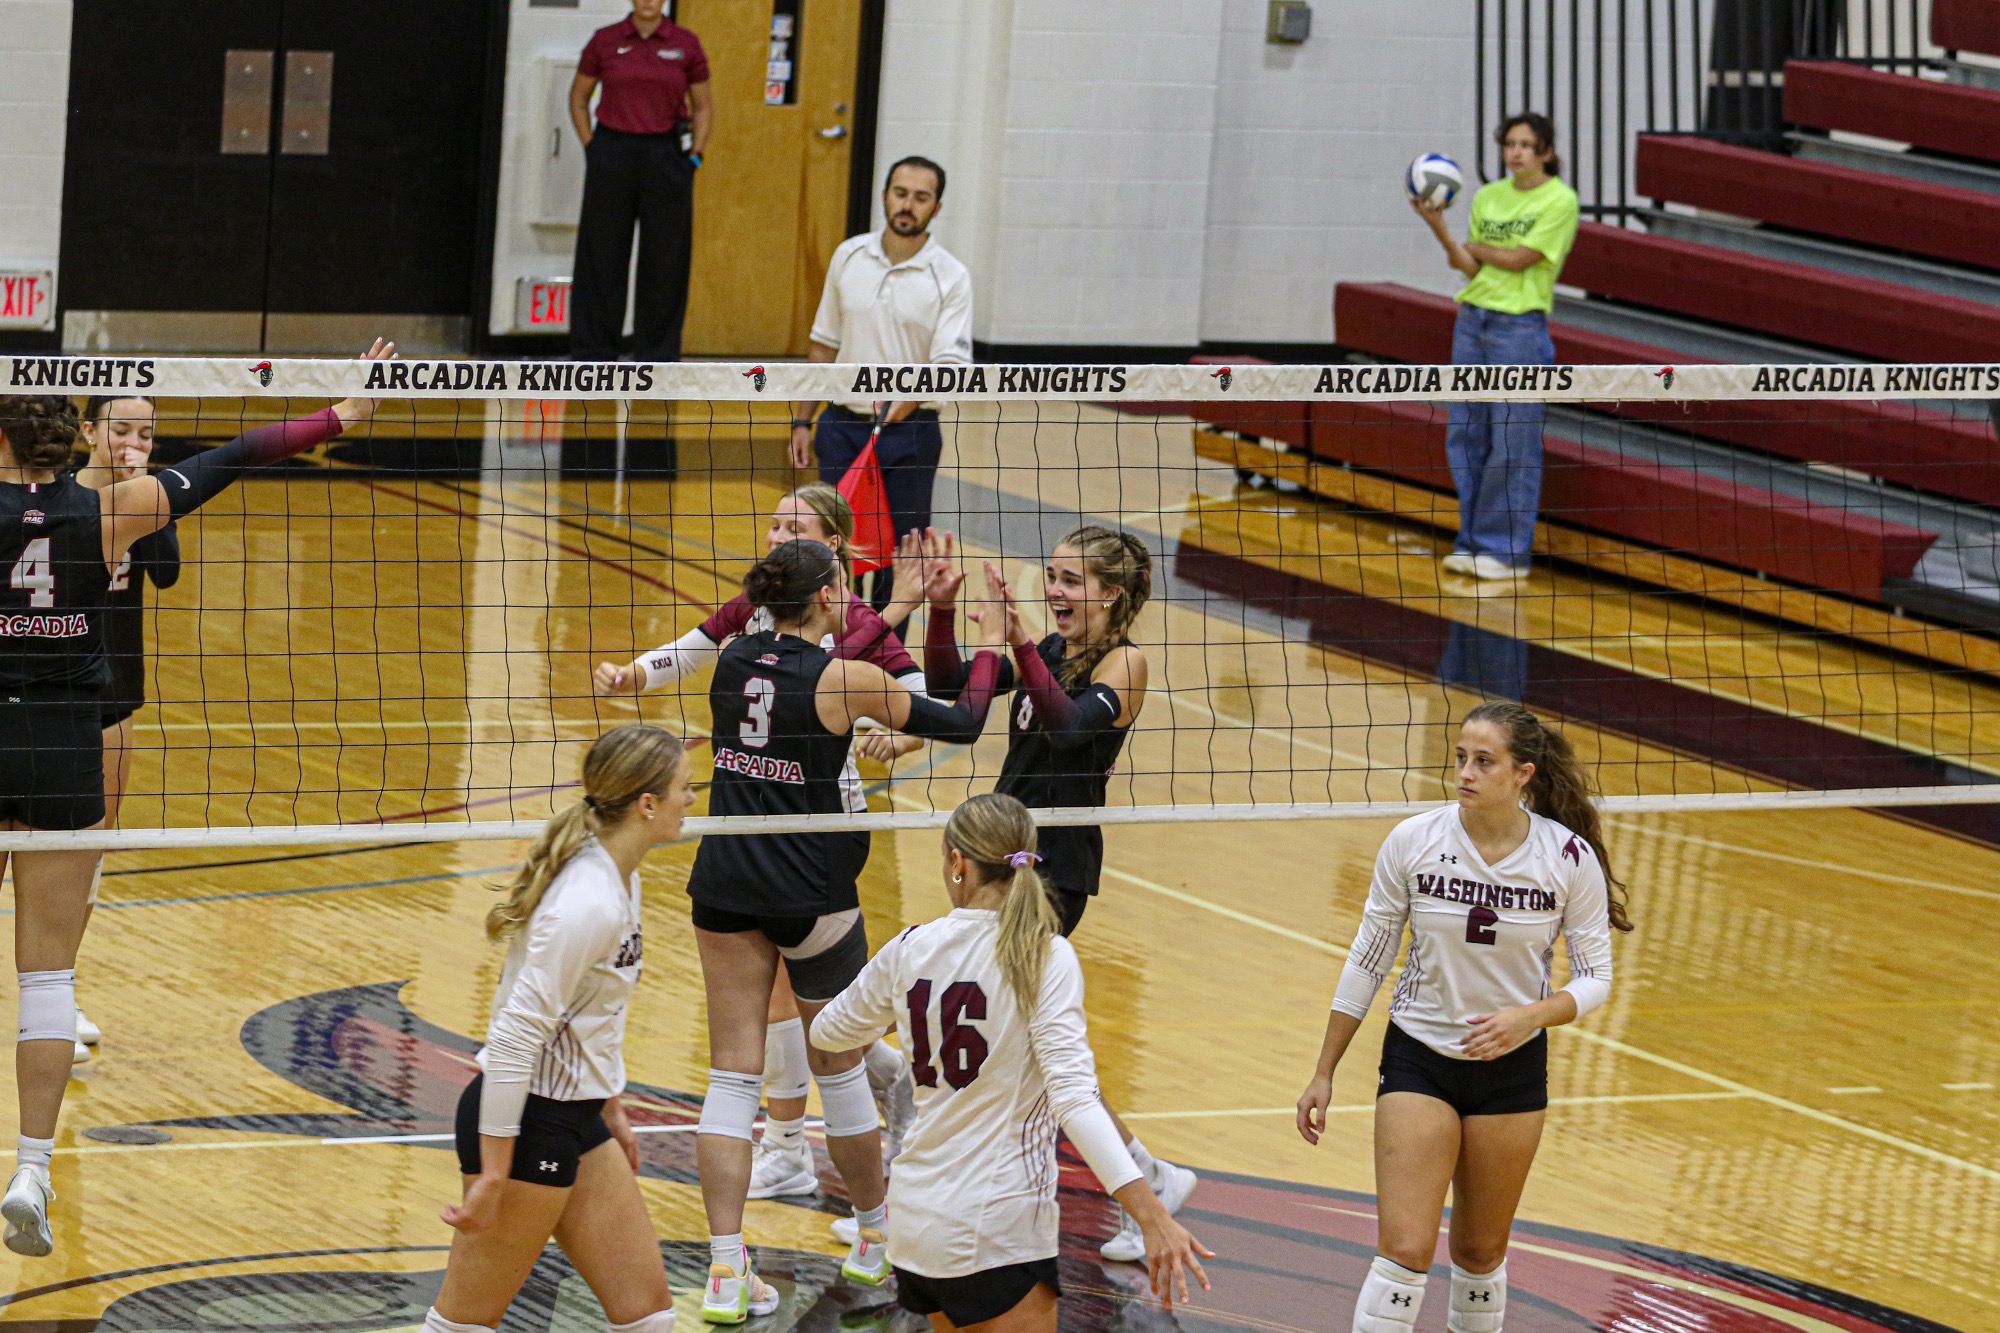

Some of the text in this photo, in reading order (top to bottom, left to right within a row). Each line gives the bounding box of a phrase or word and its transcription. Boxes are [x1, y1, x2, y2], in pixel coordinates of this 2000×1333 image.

[0, 276, 38, 318] XIT
[530, 284, 572, 324] EXI
[10, 358, 155, 388] KNIGHTS
[364, 362, 654, 392] ARCADIA KNIGHTS
[851, 366, 1127, 393] ARCADIA KNIGHTS
[1313, 366, 1573, 393] ARCADIA KNIGHTS
[1751, 366, 2000, 392] ARCADIA KNIGHTS
[10, 536, 55, 608] 4
[0, 613, 89, 638] RCADIA
[739, 677, 776, 748] 3
[714, 747, 805, 785] ARCADIA
[1416, 873, 1556, 911] WASHINGTON
[1465, 906, 1499, 946] 2
[907, 978, 989, 1092] 16
